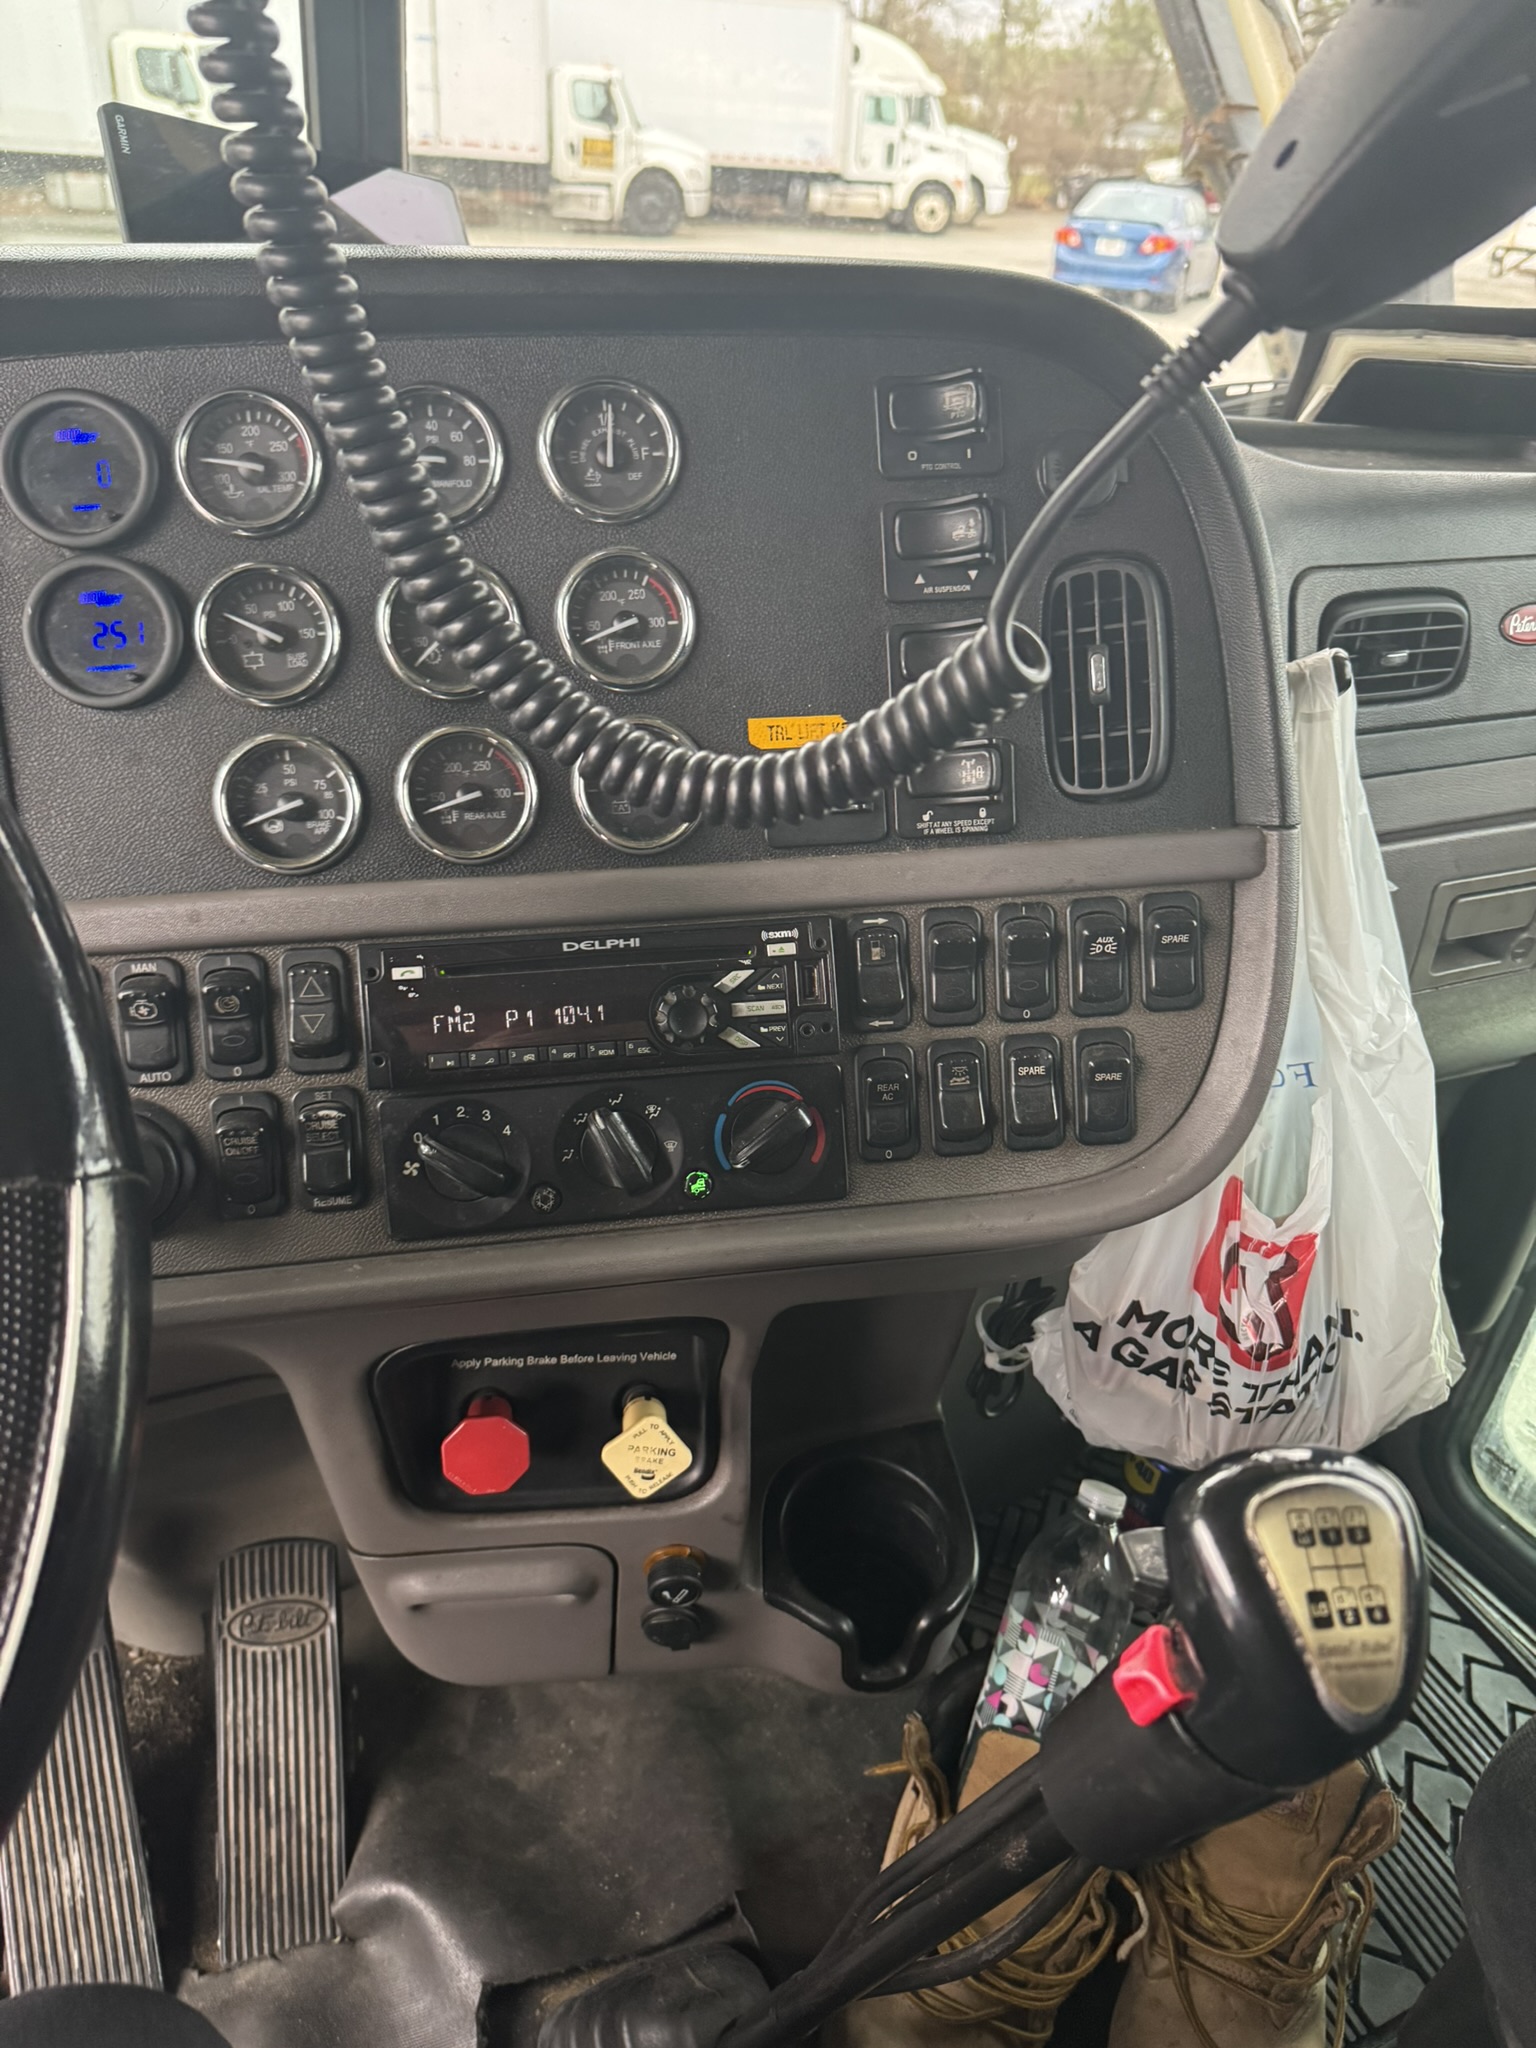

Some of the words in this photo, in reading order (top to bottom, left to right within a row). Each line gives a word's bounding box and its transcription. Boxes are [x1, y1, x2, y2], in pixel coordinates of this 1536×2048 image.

[115, 114, 131, 155] GARMIN
[241, 425, 260, 437] 200
[425, 420, 438, 431] 40
[450, 431, 463, 442] 60
[269, 441, 288, 452] 250
[641, 447, 650, 460] F
[463, 455, 476, 466] 80
[278, 471, 296, 482] 300
[628, 472, 643, 481] DEF
[272, 484, 294, 493] TEMP
[431, 479, 472, 488] MANIFOLD
[935, 584, 971, 593] SUSPENSION
[600, 590, 617, 601] 200
[627, 589, 646, 600] 250
[244, 603, 258, 614] 50
[277, 601, 295, 611] 100
[648, 617, 665, 628] 300
[615, 641, 640, 649] FRONT
[642, 639, 661, 648] AXLE
[767, 725, 792, 741] TRL
[283, 764, 296, 775] 50
[444, 762, 462, 773] 200
[473, 761, 491, 772] 250
[283, 778, 297, 787] PSI
[313, 780, 327, 790] 75
[255, 783, 268, 794] 25
[493, 788, 511, 799] 300
[318, 809, 335, 820] 100
[464, 811, 486, 820] REAR
[487, 810, 507, 819] AXLE
[306, 820, 331, 829] BRAKE
[954, 819, 973, 827] SPEED
[973, 818, 995, 826] EXCEPT
[313, 827, 329, 835] APP
[935, 827, 954, 835] WHEEL
[962, 825, 988, 833] SPINNING
[769, 930, 791, 939] sxm
[1161, 934, 1190, 944] SPARE
[563, 937, 641, 952] DELPHI
[131, 963, 157, 973] MAN
[730, 973, 741, 984] SRC
[766, 982, 783, 990] NEXT
[433, 1012, 475, 1034] FM2
[554, 1004, 605, 1026] 104.1
[637, 1046, 651, 1054] ESC
[1018, 1065, 1046, 1076] SPARE
[139, 1071, 172, 1084] AUTO
[1094, 1072, 1122, 1082] SPARE
[877, 1083, 900, 1092] REAR
[314, 1090, 332, 1101] SET
[882, 1093, 894, 1101] AC
[456, 1106, 465, 1118] 2
[482, 1109, 491, 1121] 3
[304, 1119, 339, 1131] CRUISE
[432, 1114, 439, 1126] 1
[502, 1124, 511, 1136] 4
[223, 1137, 259, 1147] CRUISE
[305, 1131, 339, 1142] SELECT
[413, 1132, 423, 1144] 0
[313, 1195, 352, 1207] RESUME
[1117, 1300, 1231, 1387] MORE
[451, 1357, 481, 1369] Apply
[484, 1356, 524, 1368] Parking
[527, 1355, 557, 1366] Brake
[560, 1353, 594, 1364] Before
[597, 1352, 637, 1364] Leaving
[639, 1351, 677, 1361] Vehicle
[1073, 1321, 1102, 1352] A
[1111, 1337, 1202, 1395] GAS
[633, 1428, 648, 1439] PULL
[660, 1430, 675, 1445] APPLY
[628, 1445, 676, 1457] PARKING
[649, 1471, 673, 1490] RELEASE
